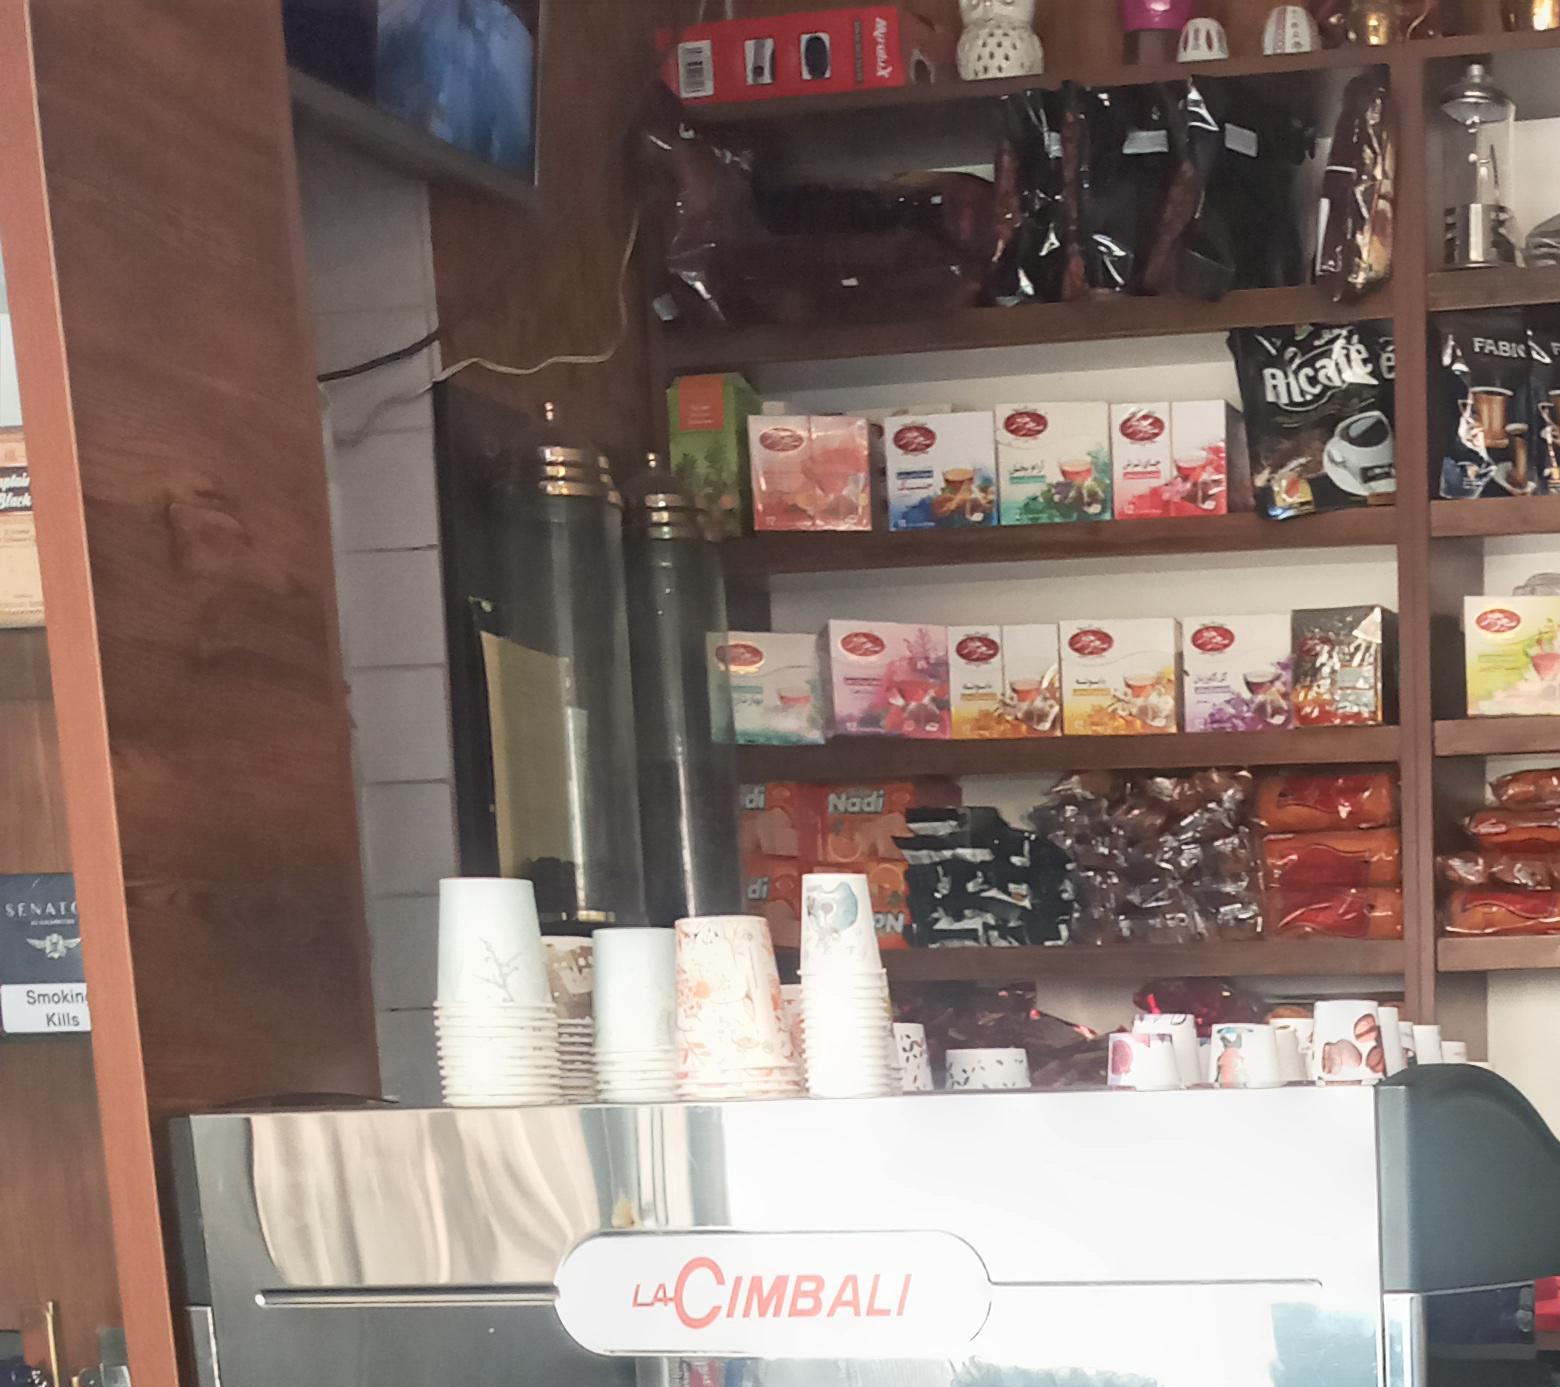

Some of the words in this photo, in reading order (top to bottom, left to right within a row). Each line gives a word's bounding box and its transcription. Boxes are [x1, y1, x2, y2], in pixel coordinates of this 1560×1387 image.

[827, 789, 885, 813] Nadi
[26, 989, 87, 1006] Smokin
[46, 1012, 80, 1027] Kills
